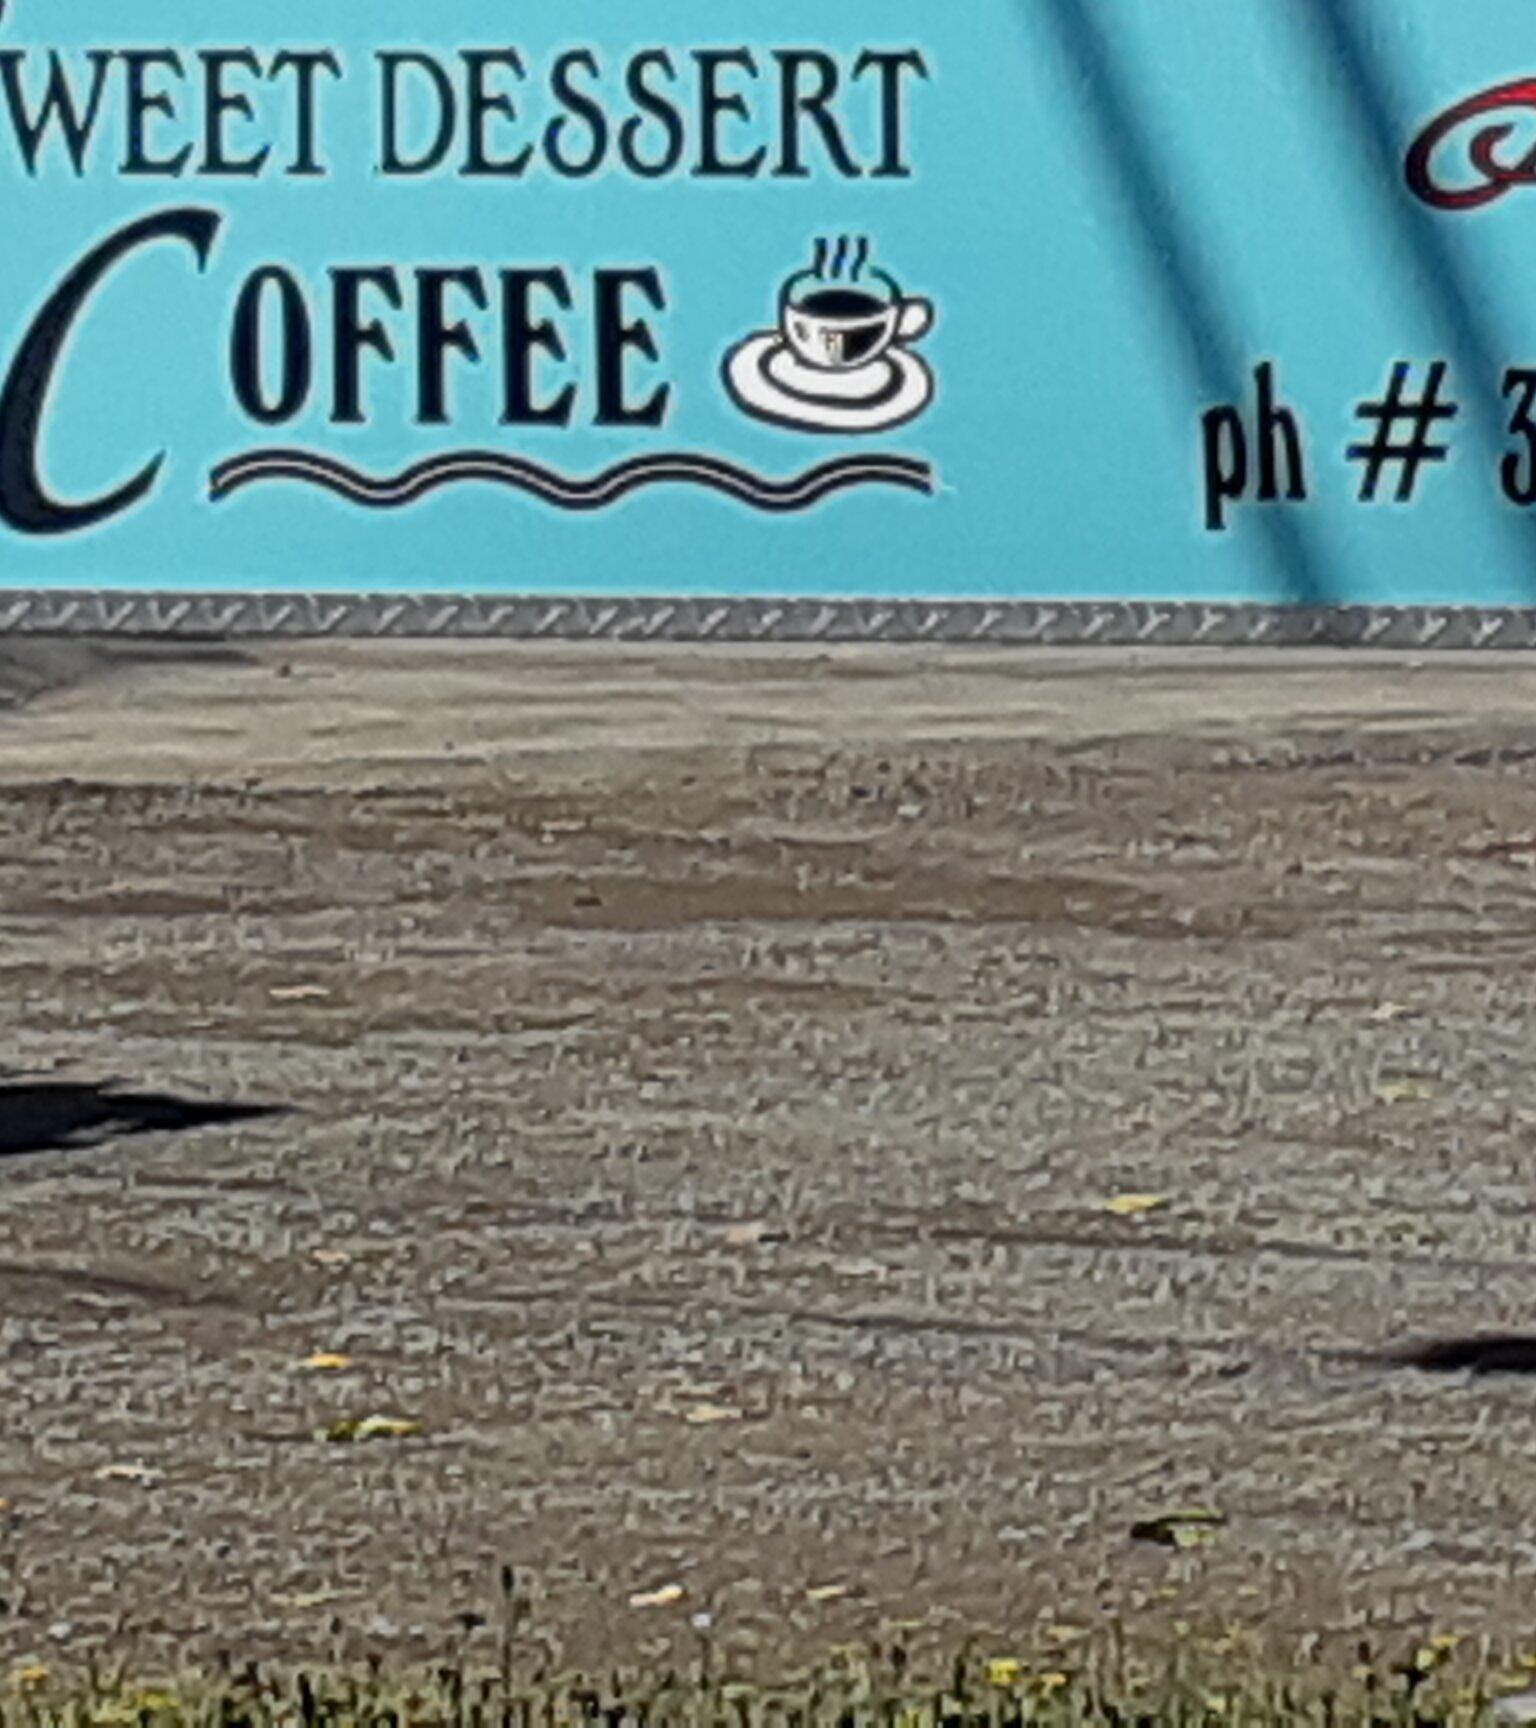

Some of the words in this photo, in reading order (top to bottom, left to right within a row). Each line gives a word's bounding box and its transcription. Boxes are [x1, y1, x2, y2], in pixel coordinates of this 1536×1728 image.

[373, 46, 929, 179] DESSERT
[1199, 360, 1307, 532] ph
[1344, 360, 1457, 504] #
